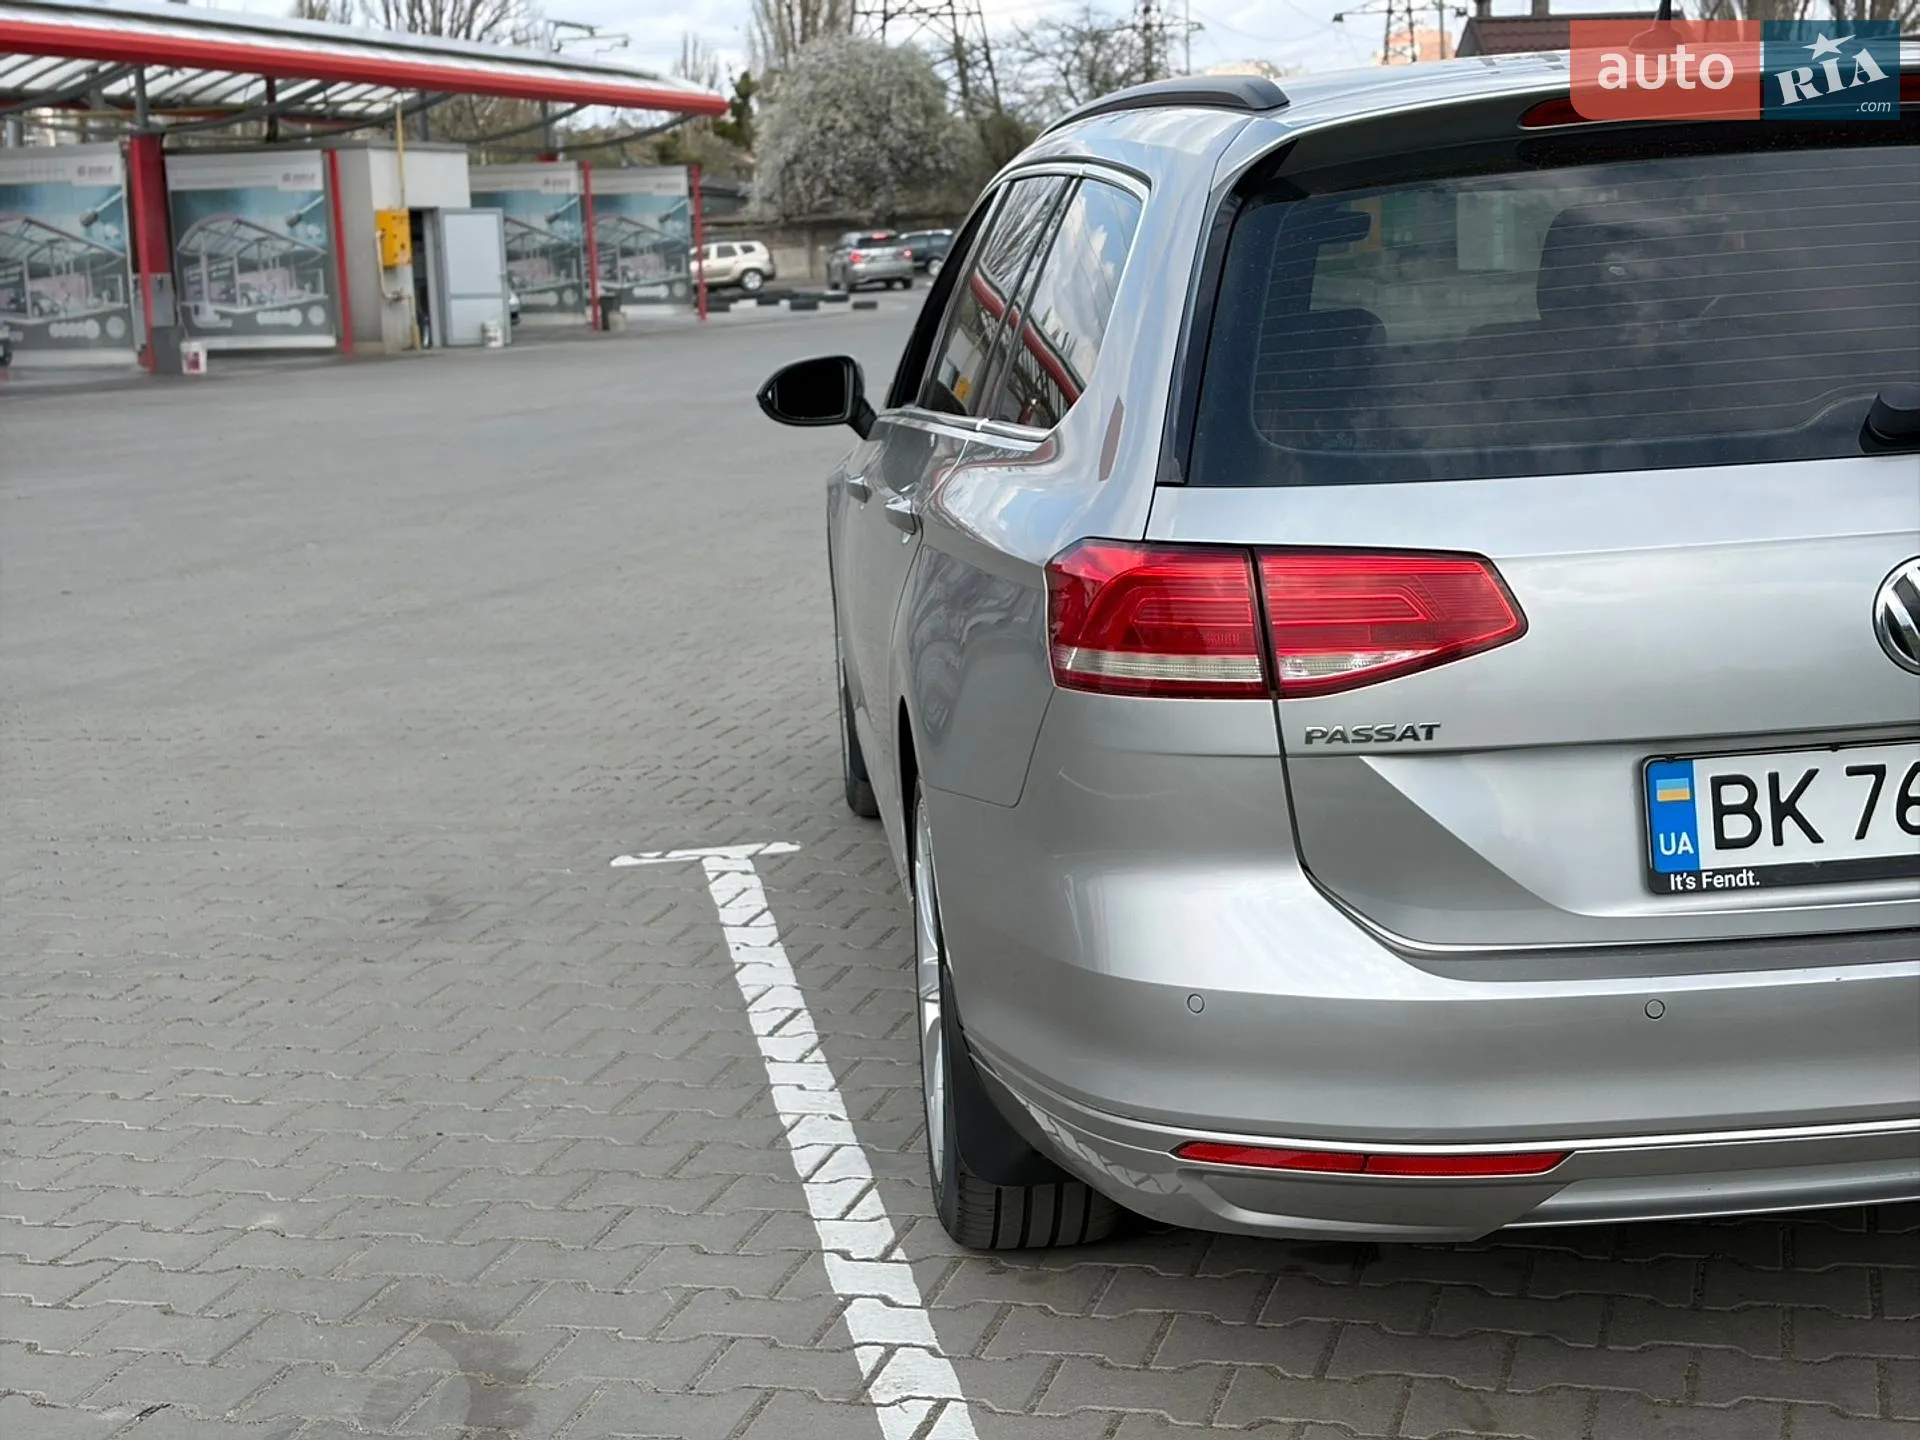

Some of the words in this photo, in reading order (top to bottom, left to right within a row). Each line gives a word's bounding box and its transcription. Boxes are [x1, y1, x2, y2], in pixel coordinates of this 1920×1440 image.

[1305, 722, 1441, 745] PASSAT
[1710, 768, 1824, 850] BK
[1659, 831, 1694, 856] UA
[1701, 868, 1760, 889] Fendt.
